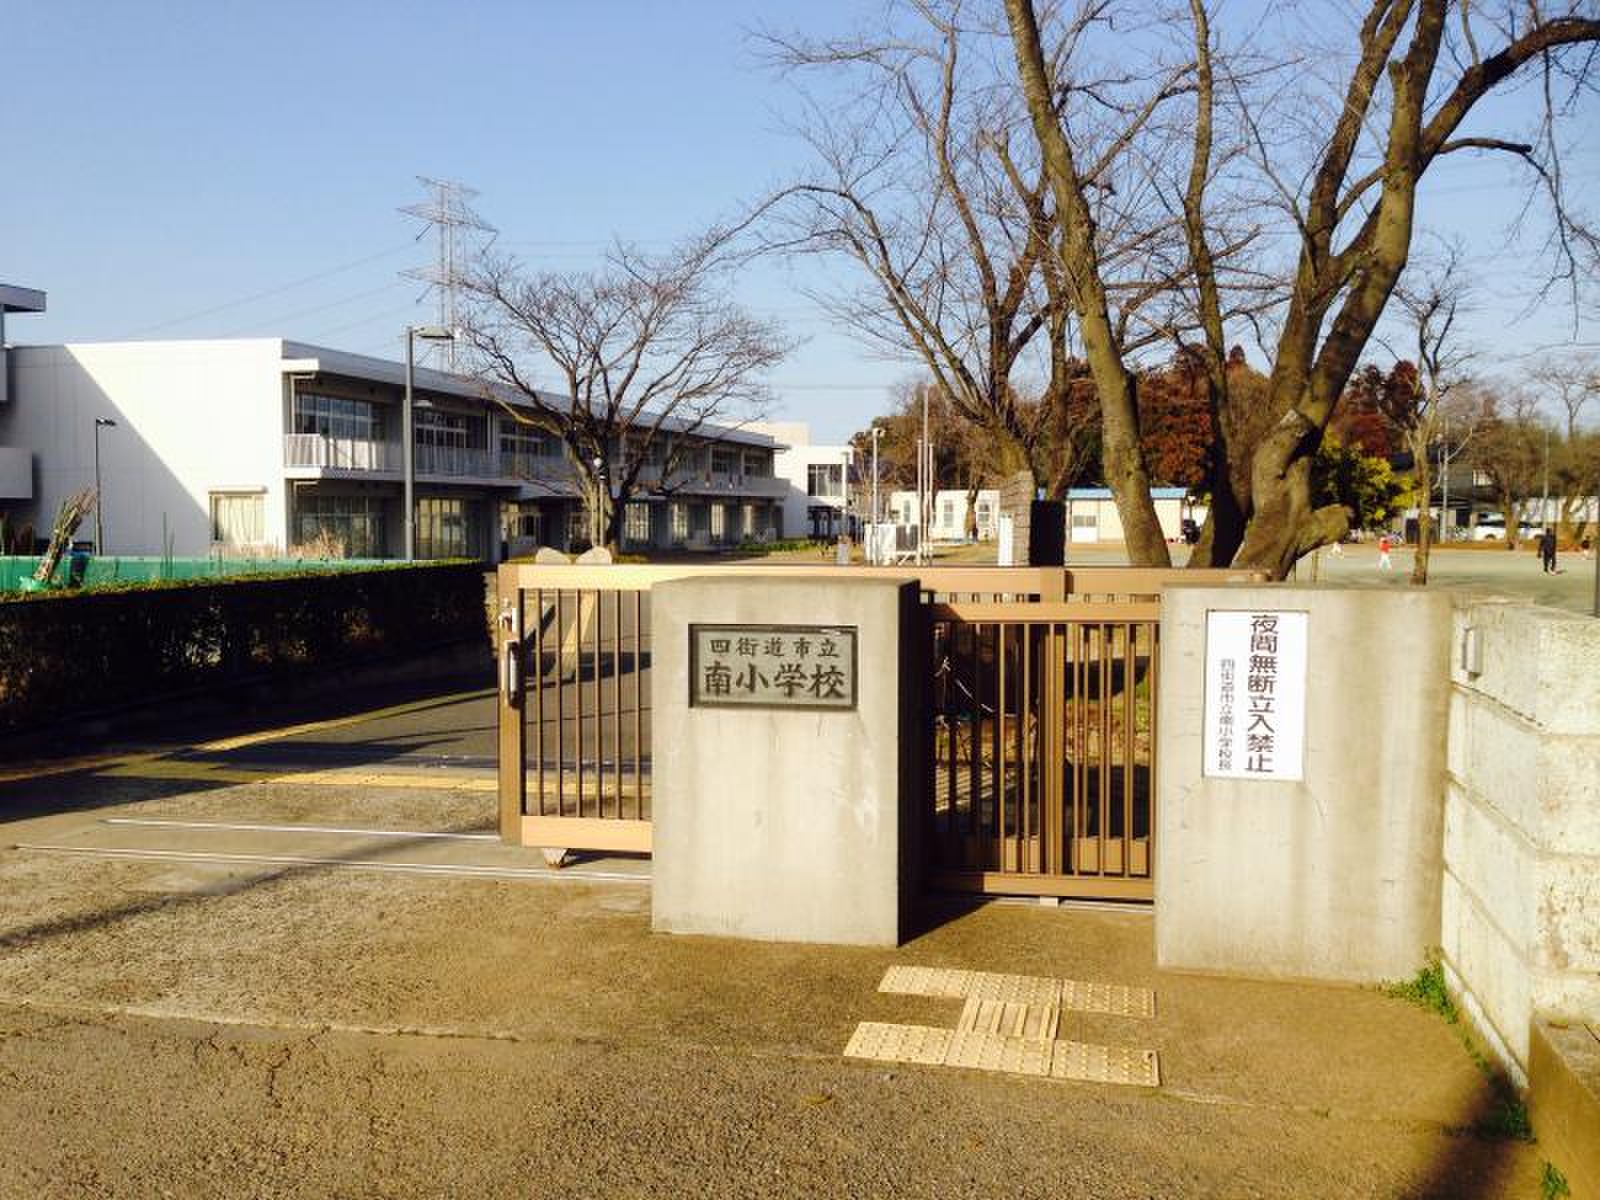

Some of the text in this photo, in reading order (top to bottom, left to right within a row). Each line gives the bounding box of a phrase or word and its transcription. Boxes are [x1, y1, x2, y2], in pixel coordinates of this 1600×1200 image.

[709, 637, 840, 659] 四街道市立
[704, 660, 846, 699] 南小学校
[1245, 614, 1280, 773] 夜間無断立入禁止
